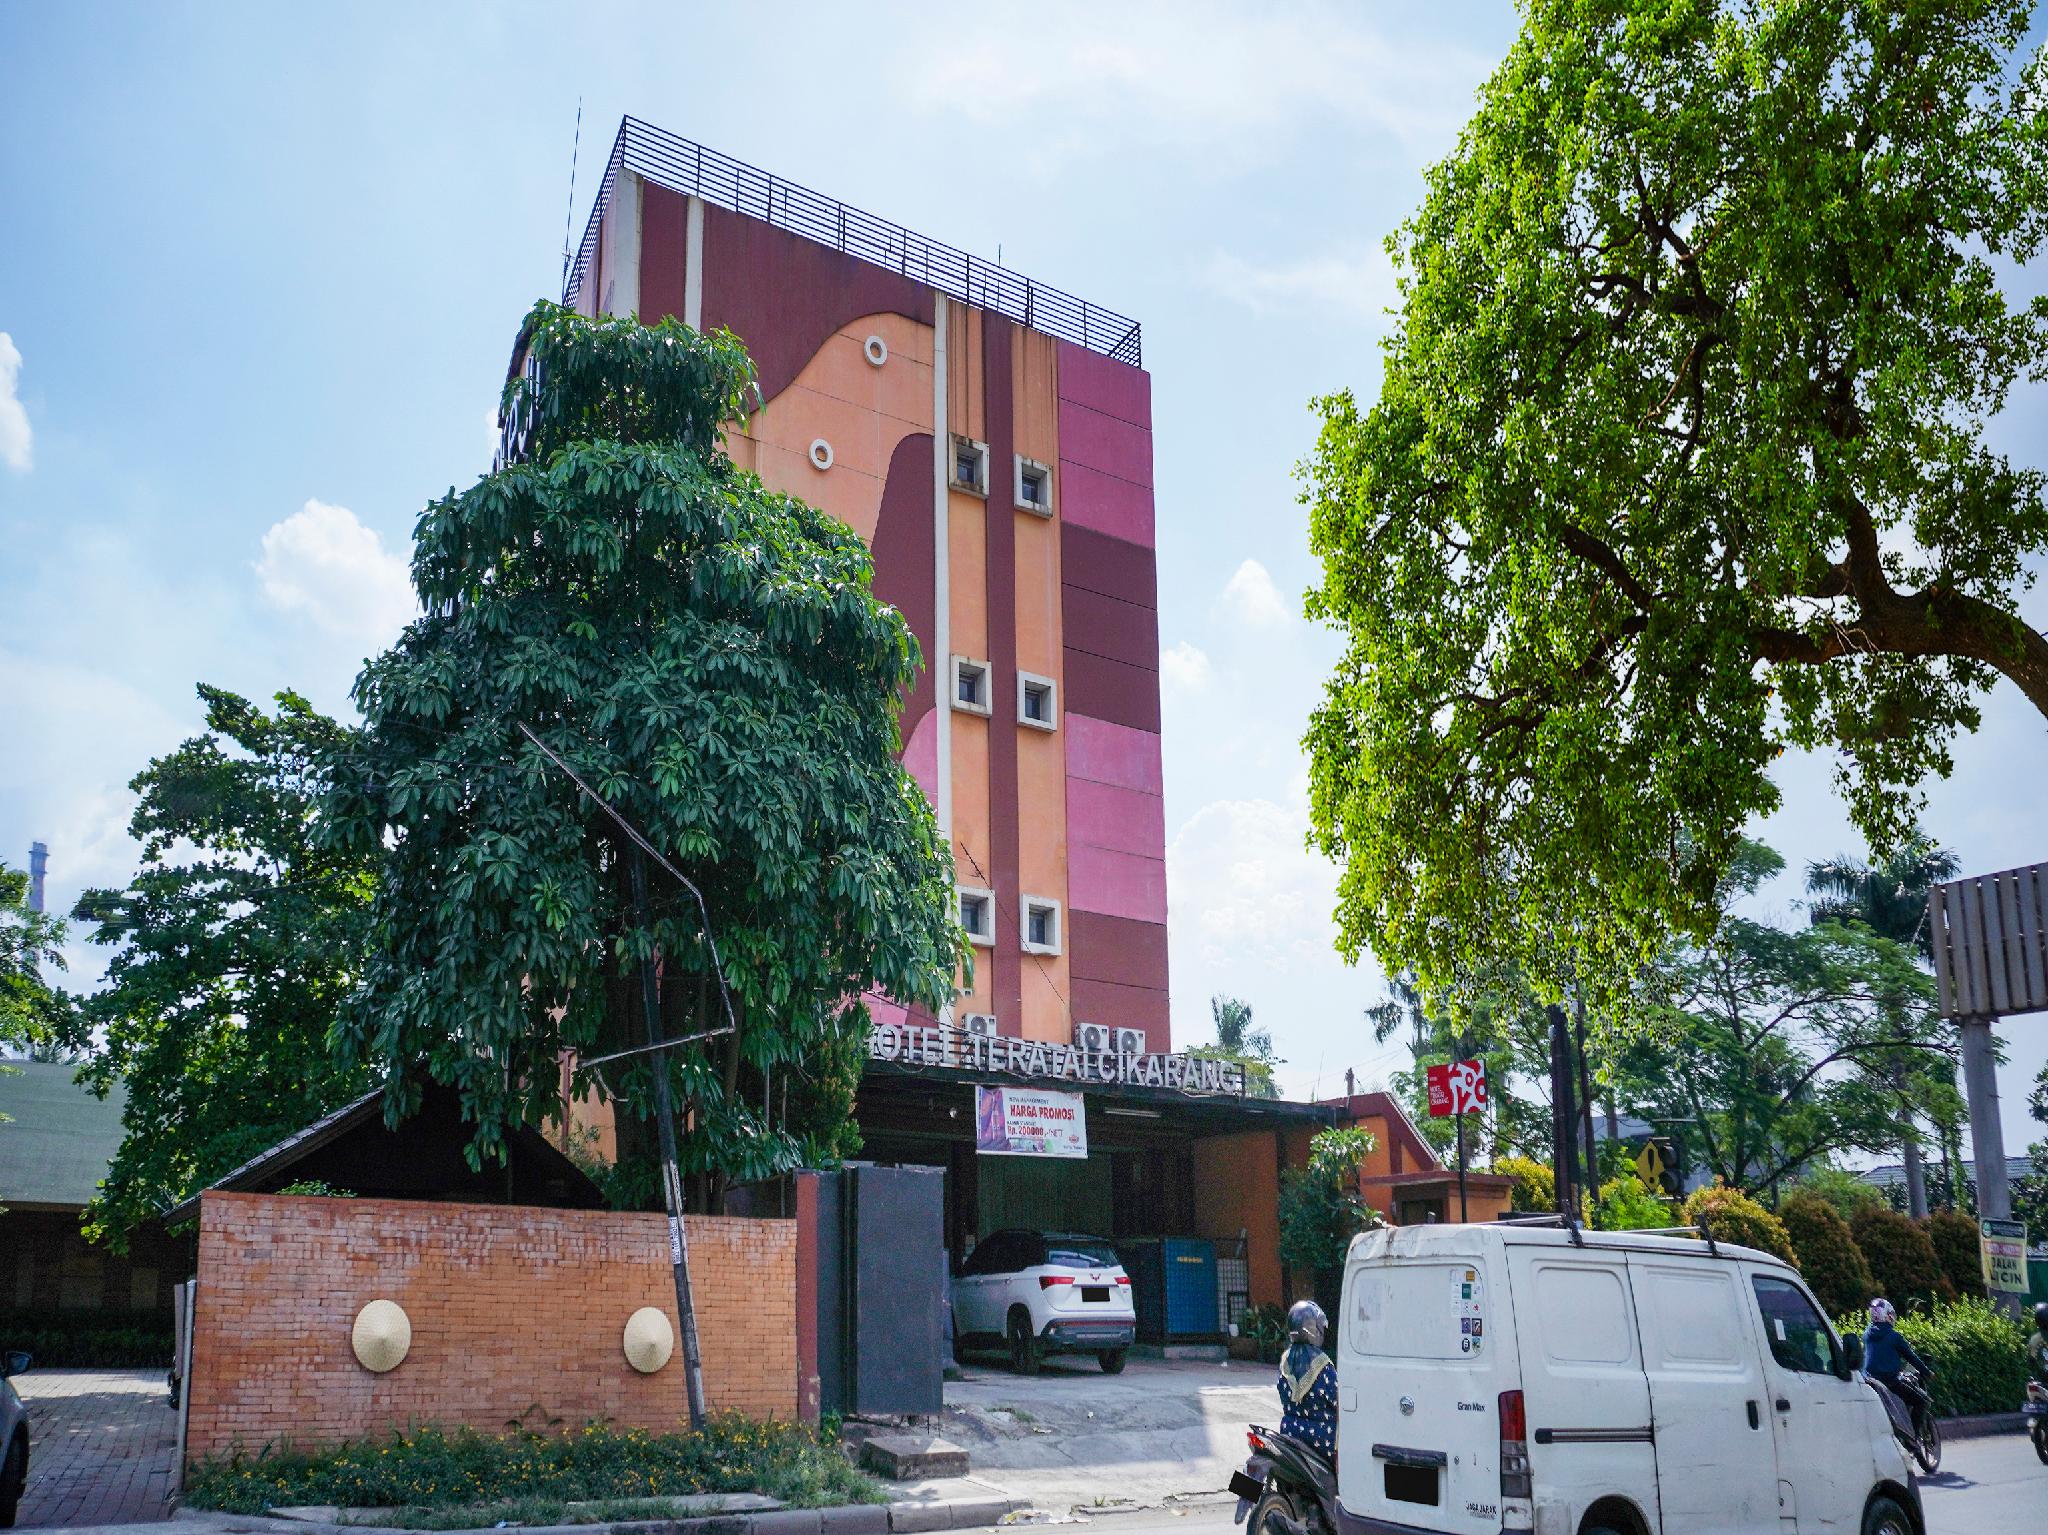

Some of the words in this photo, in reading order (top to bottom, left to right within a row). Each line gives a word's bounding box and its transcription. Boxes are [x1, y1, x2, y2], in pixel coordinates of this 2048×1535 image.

[968, 1033, 1089, 1080] TERATAI
[1099, 1047, 1237, 1095] CIKARANG
[1010, 1104, 1038, 1118] HARGA
[1039, 1106, 1075, 1121] PROMOSI
[1457, 1401, 1472, 1411] Gran
[1472, 1402, 1486, 1413] Max
